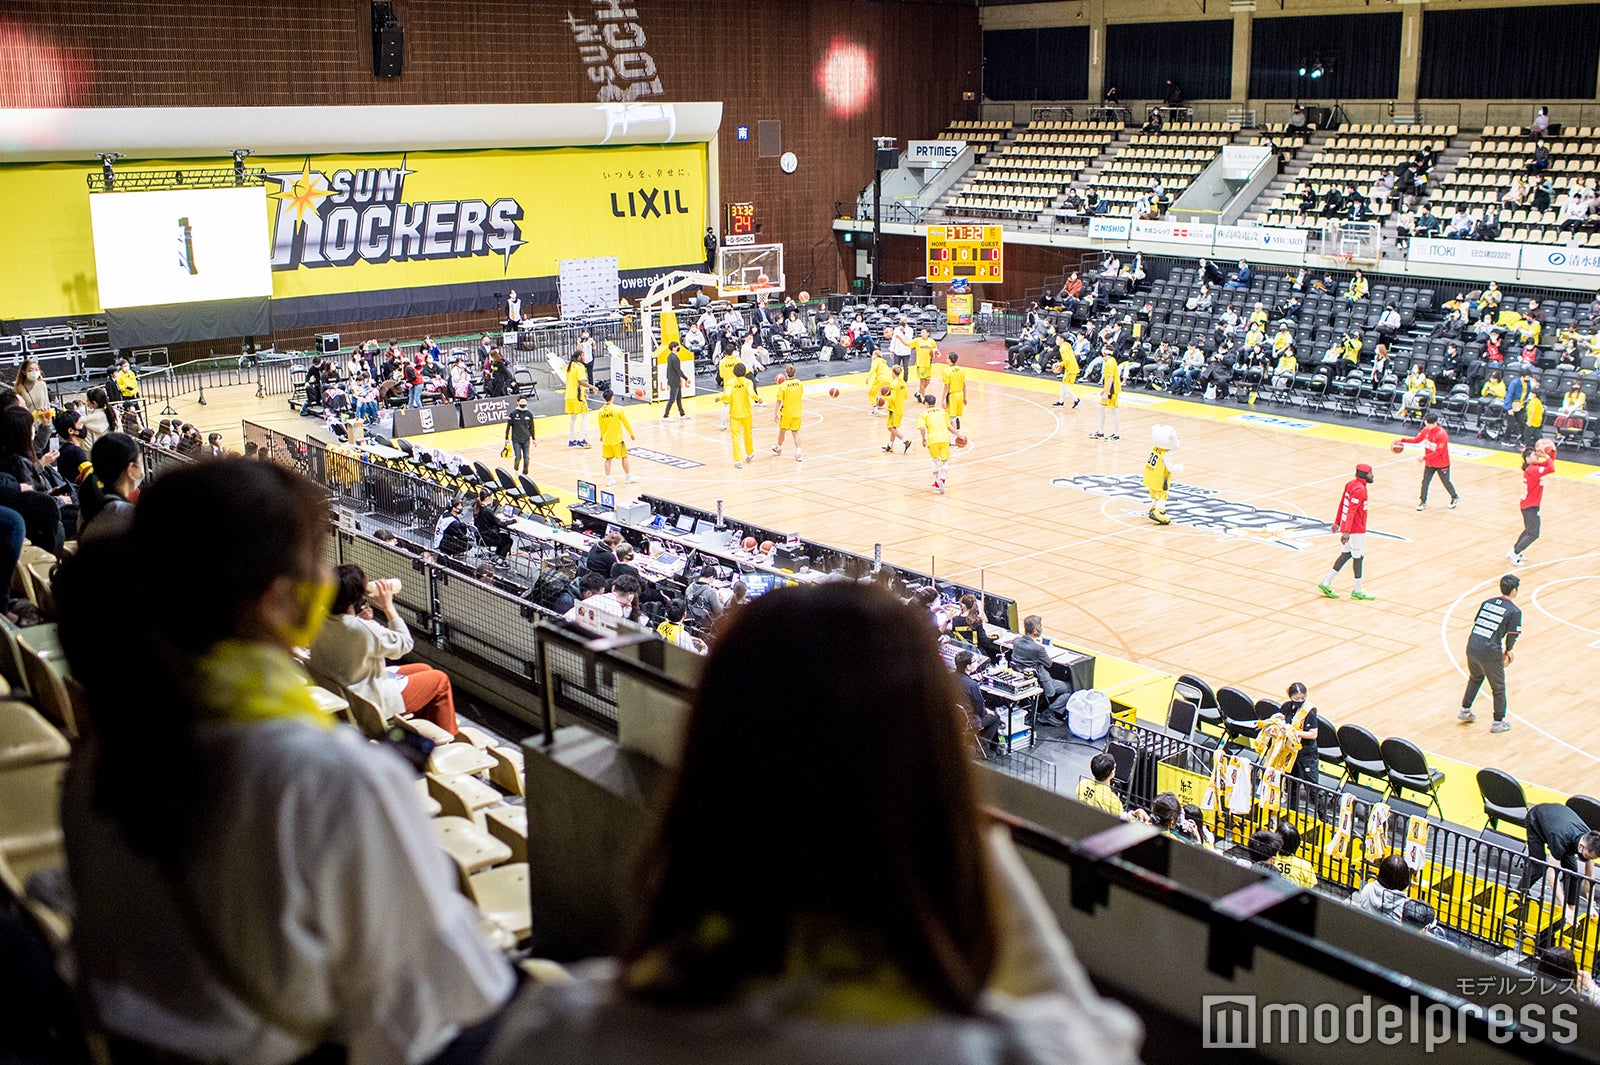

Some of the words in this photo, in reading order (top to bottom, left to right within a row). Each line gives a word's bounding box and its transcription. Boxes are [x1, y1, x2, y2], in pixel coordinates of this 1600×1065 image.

[738, 127, 748, 140] 南
[603, 168, 690, 180] いつもを、幸せに。
[331, 168, 403, 206] SUN
[610, 187, 689, 220] LIXIL
[731, 205, 754, 217] 37:32
[268, 172, 526, 270] ROCKERS
[735, 215, 751, 233] 24
[947, 226, 983, 240] 37:32
[1100, 224, 1126, 234] NISHIO
[1272, 237, 1304, 246] MICARD
[941, 248, 949, 261] 0
[961, 249, 968, 260] 0
[991, 248, 999, 261] 0
[1429, 245, 1456, 258] ITOKI
[933, 265, 940, 276] 0
[992, 265, 999, 276] 0
[487, 410, 508, 422] LIVE
[1083, 786, 1095, 799] 36
[1277, 863, 1291, 874] 36
